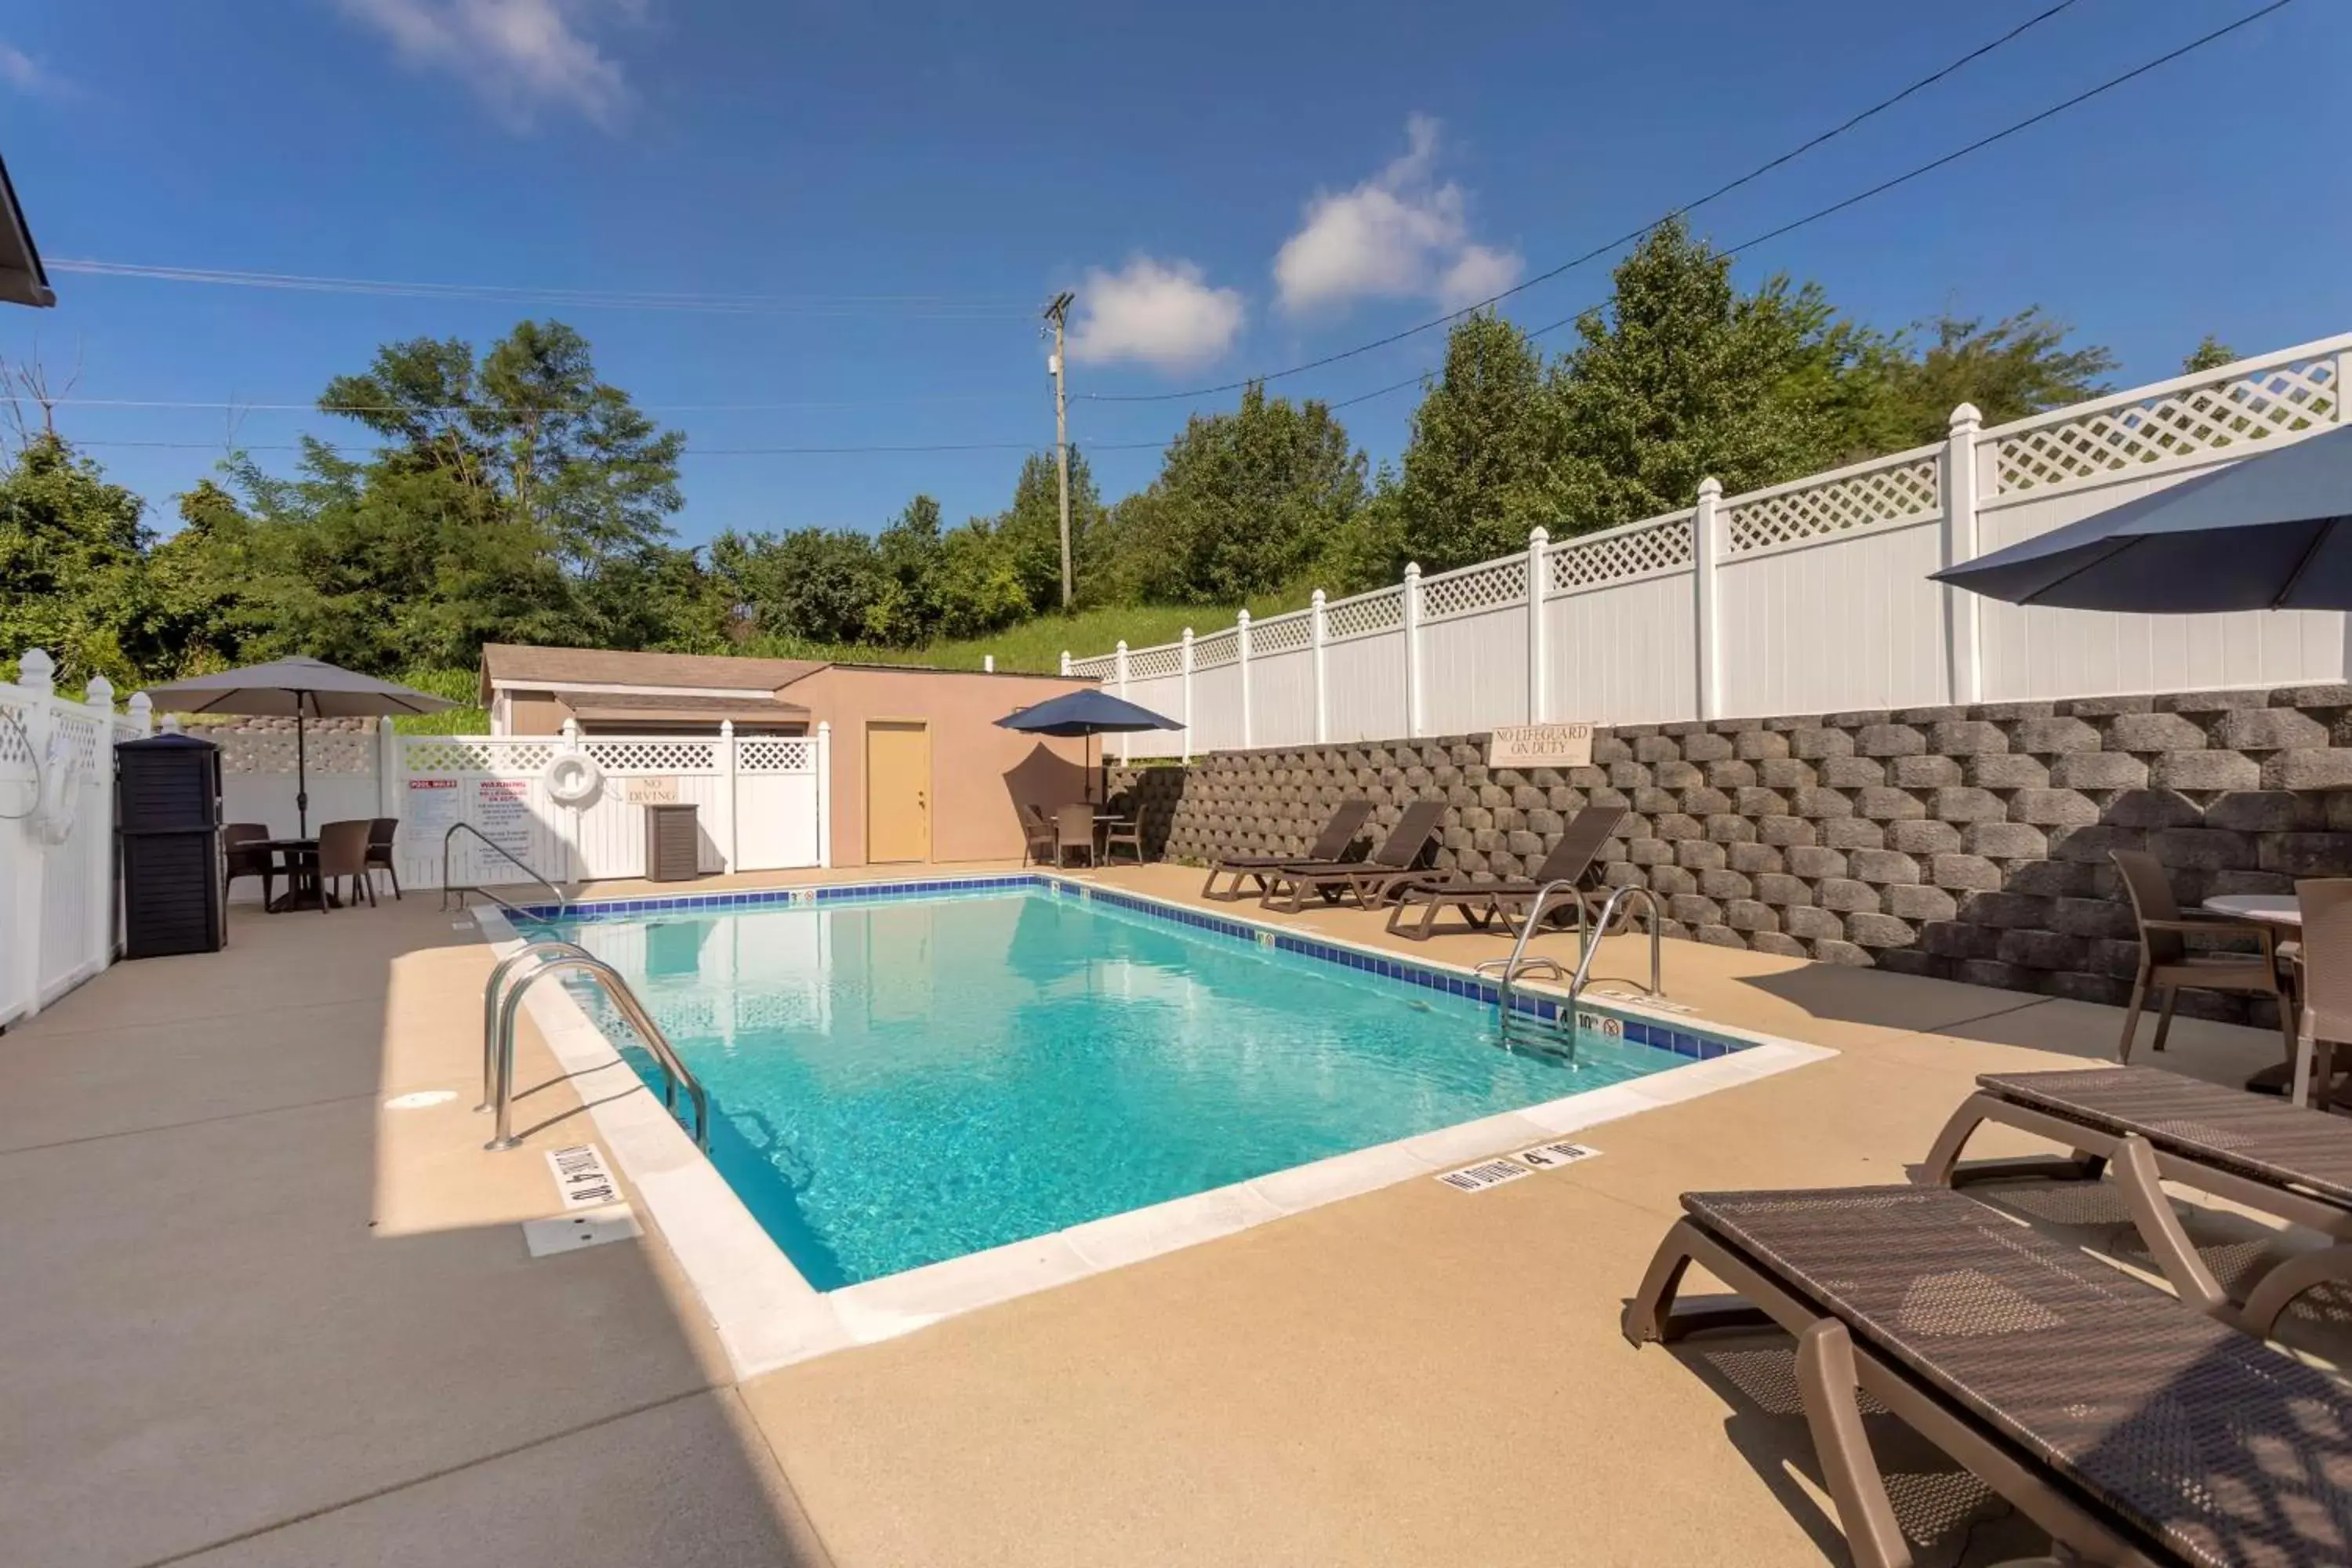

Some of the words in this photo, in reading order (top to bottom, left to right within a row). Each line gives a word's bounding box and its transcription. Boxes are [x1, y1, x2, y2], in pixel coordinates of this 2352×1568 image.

[1497, 728, 1513, 742] NO
[1515, 725, 1588, 742] LIFEGUARD
[1511, 742, 1528, 754] ON
[1532, 741, 1568, 754] DUTY
[644, 779, 662, 789] NO
[629, 790, 677, 801] DIVING
